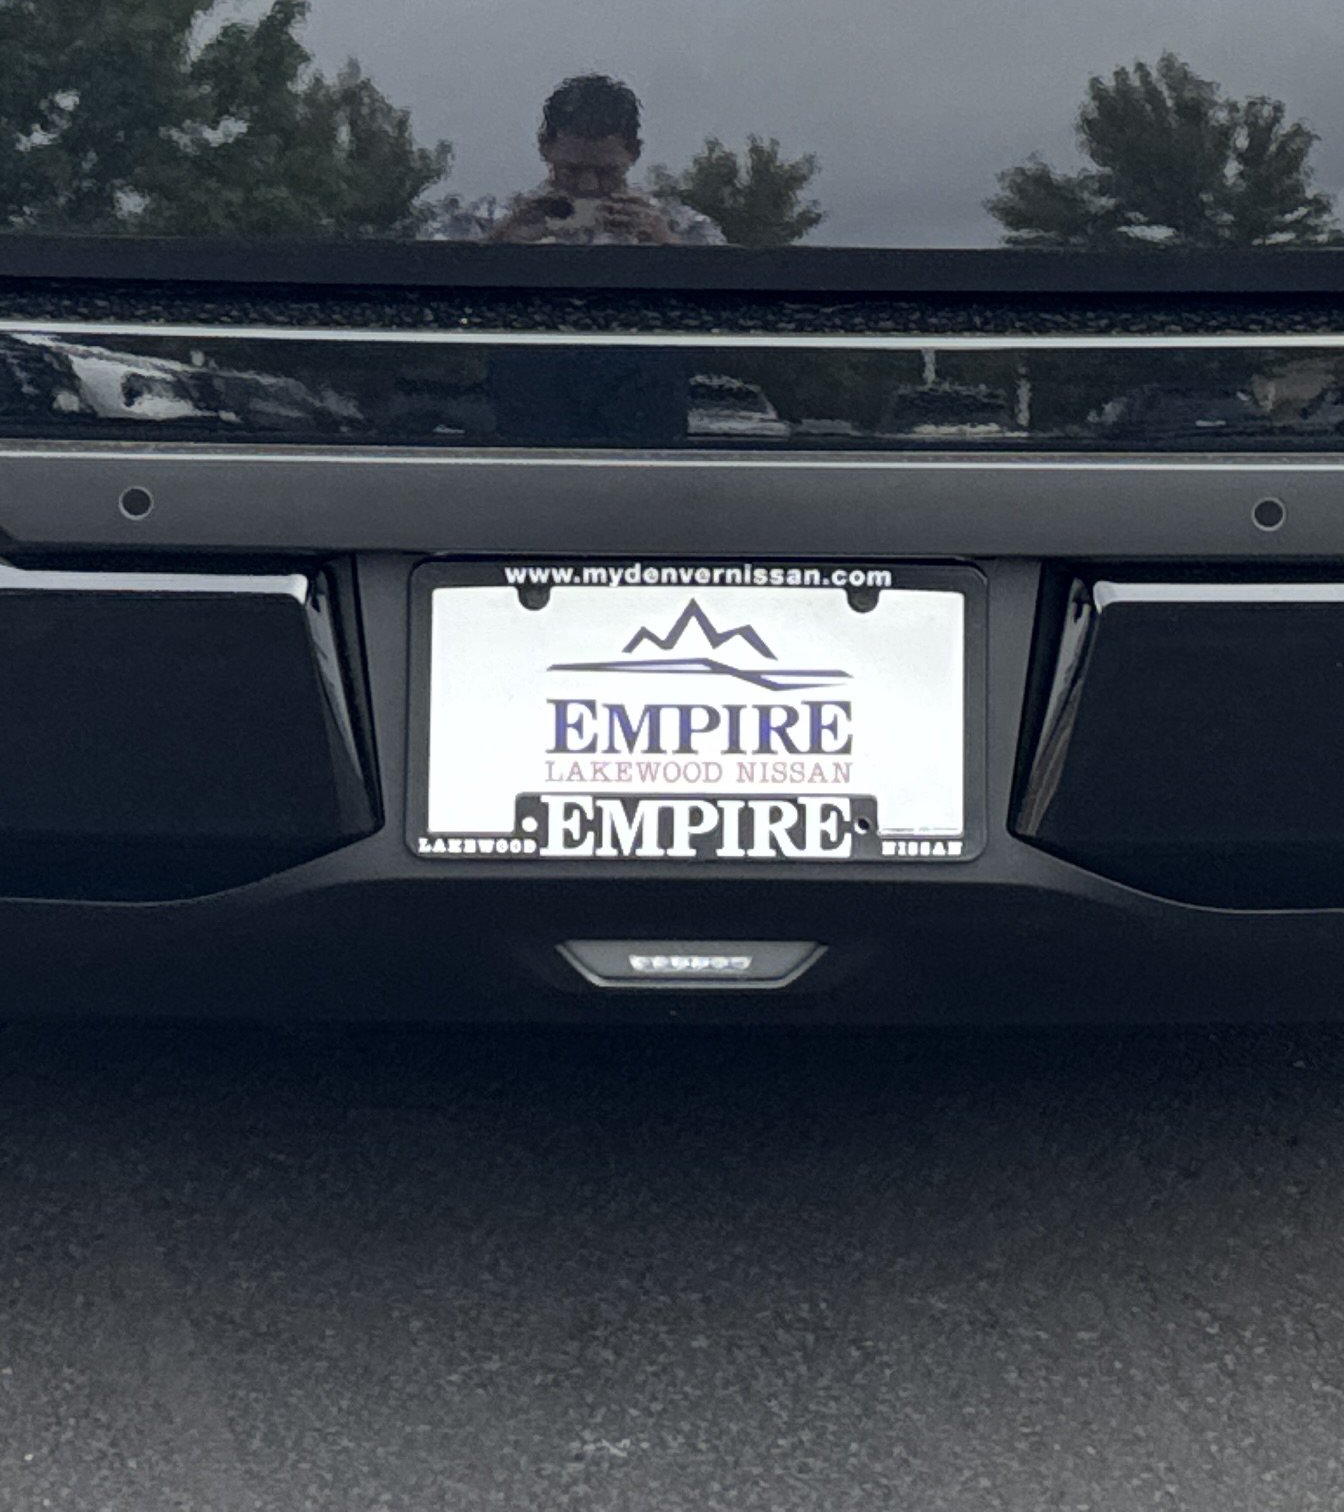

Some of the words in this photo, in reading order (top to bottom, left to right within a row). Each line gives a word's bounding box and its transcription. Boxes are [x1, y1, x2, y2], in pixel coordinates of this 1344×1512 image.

[504, 563, 892, 587] www.mydenvernissan.com
[545, 699, 854, 755] EMPIRE
[545, 761, 723, 784] LAKEWOOD
[736, 762, 853, 784] NISSAN
[540, 794, 853, 858] EMPIRE
